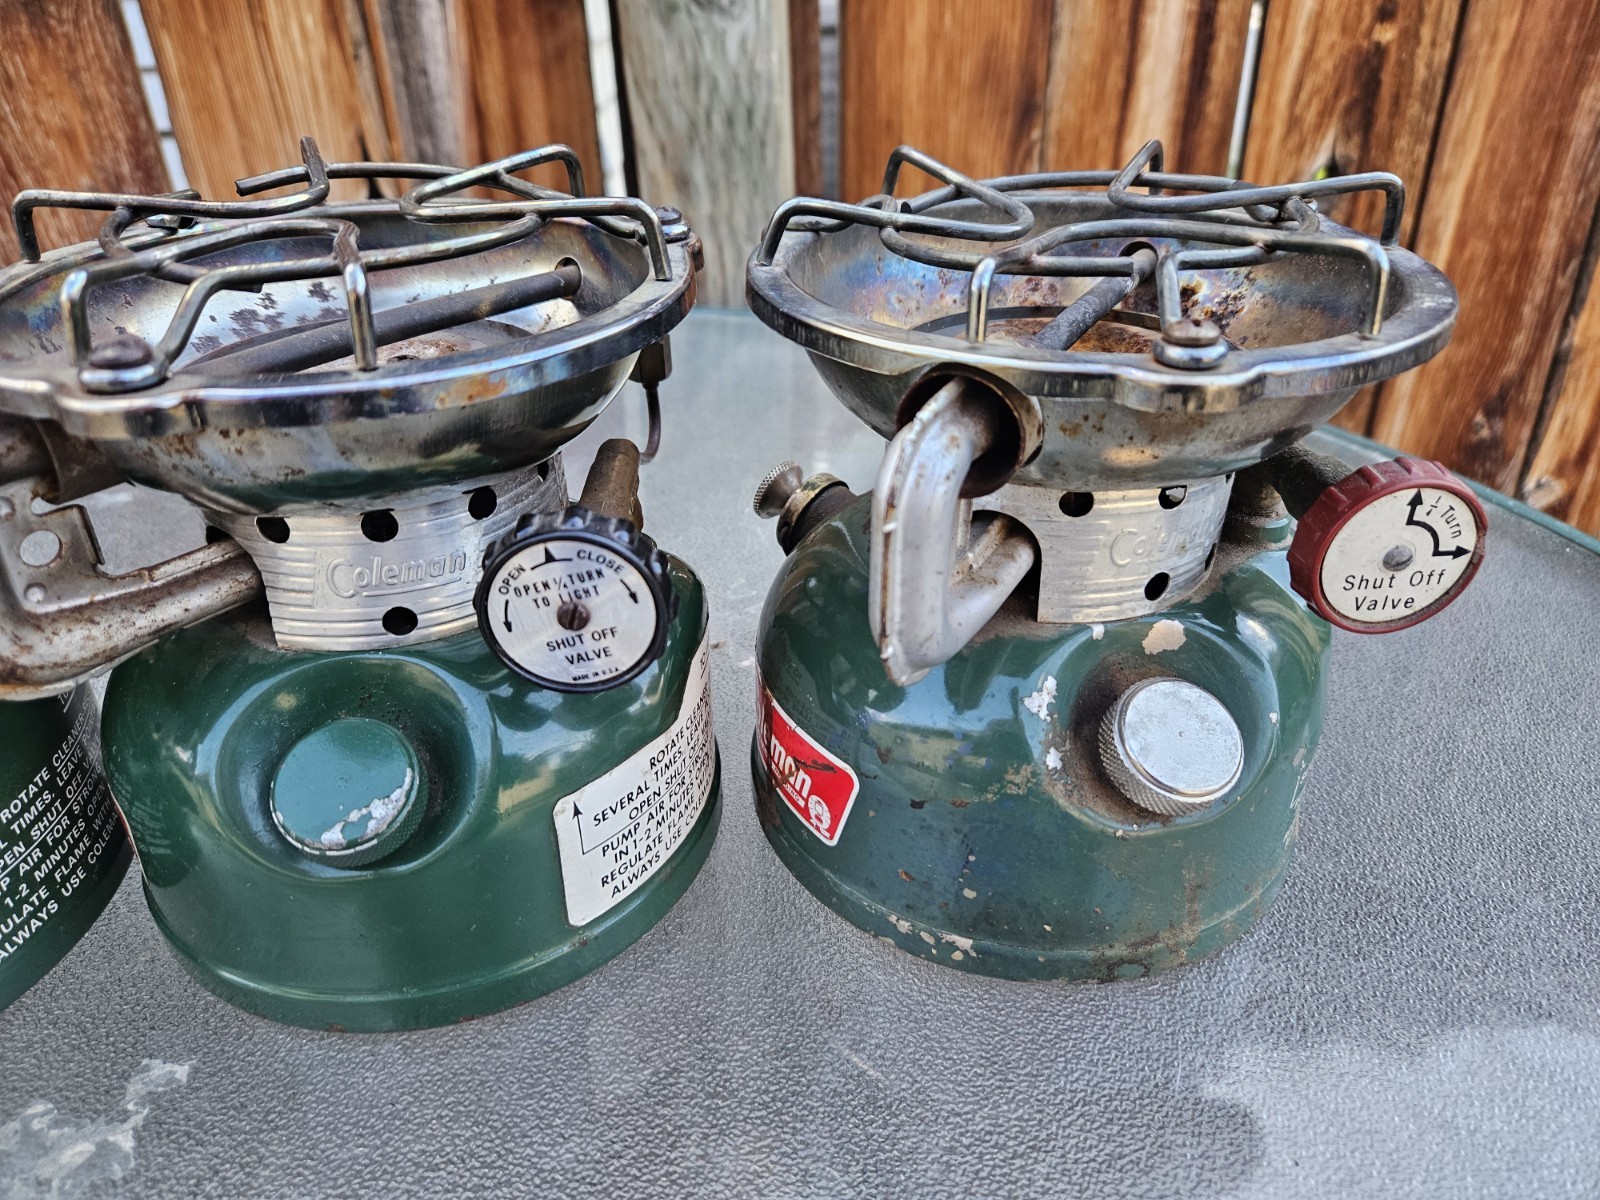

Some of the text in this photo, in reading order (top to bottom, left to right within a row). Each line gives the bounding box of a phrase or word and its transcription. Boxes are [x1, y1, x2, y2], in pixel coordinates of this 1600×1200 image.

[1440, 505, 1462, 539] Turn
[327, 550, 467, 598] Coleman
[498, 564, 527, 595] OPEN
[514, 579, 551, 598] OPEN
[566, 568, 606, 587] TURN
[576, 549, 625, 574] CLOSE
[1343, 568, 1447, 592] Shut Off
[532, 584, 601, 609] TO LIGHT
[1354, 595, 1415, 612] Valve
[546, 626, 619, 652] SHUT OFF
[564, 646, 613, 665] VALVE
[572, 673, 590, 681] MADE
[56, 745, 83, 787] LEAVE
[593, 780, 650, 827] SEVERAL
[686, 712, 704, 747] LEAVE
[649, 726, 685, 770] ROTATE
[0, 766, 51, 824] ROTATE
[629, 734, 700, 821] OPEN SHUT OFF
[19, 761, 102, 877] AIR FOR STRONG
[30, 799, 63, 841] SHUT
[66, 770, 82, 799] OFF
[602, 821, 641, 857] PUMP
[646, 800, 665, 826] AIR
[669, 775, 686, 802] FOR
[614, 845, 629, 864] IN
[633, 828, 652, 850] 1-2
[655, 777, 694, 832] MINUTES
[4, 780, 106, 908] 1-2 MINUTES OPEN
[601, 831, 663, 888] REGULATE
[667, 791, 695, 834] FLAME
[611, 850, 661, 899] ALWAYS
[665, 825, 682, 851] USE
[0, 797, 111, 938] ULATE FLAME WITH
[0, 812, 118, 963] ALWAYS USE COLEMA
